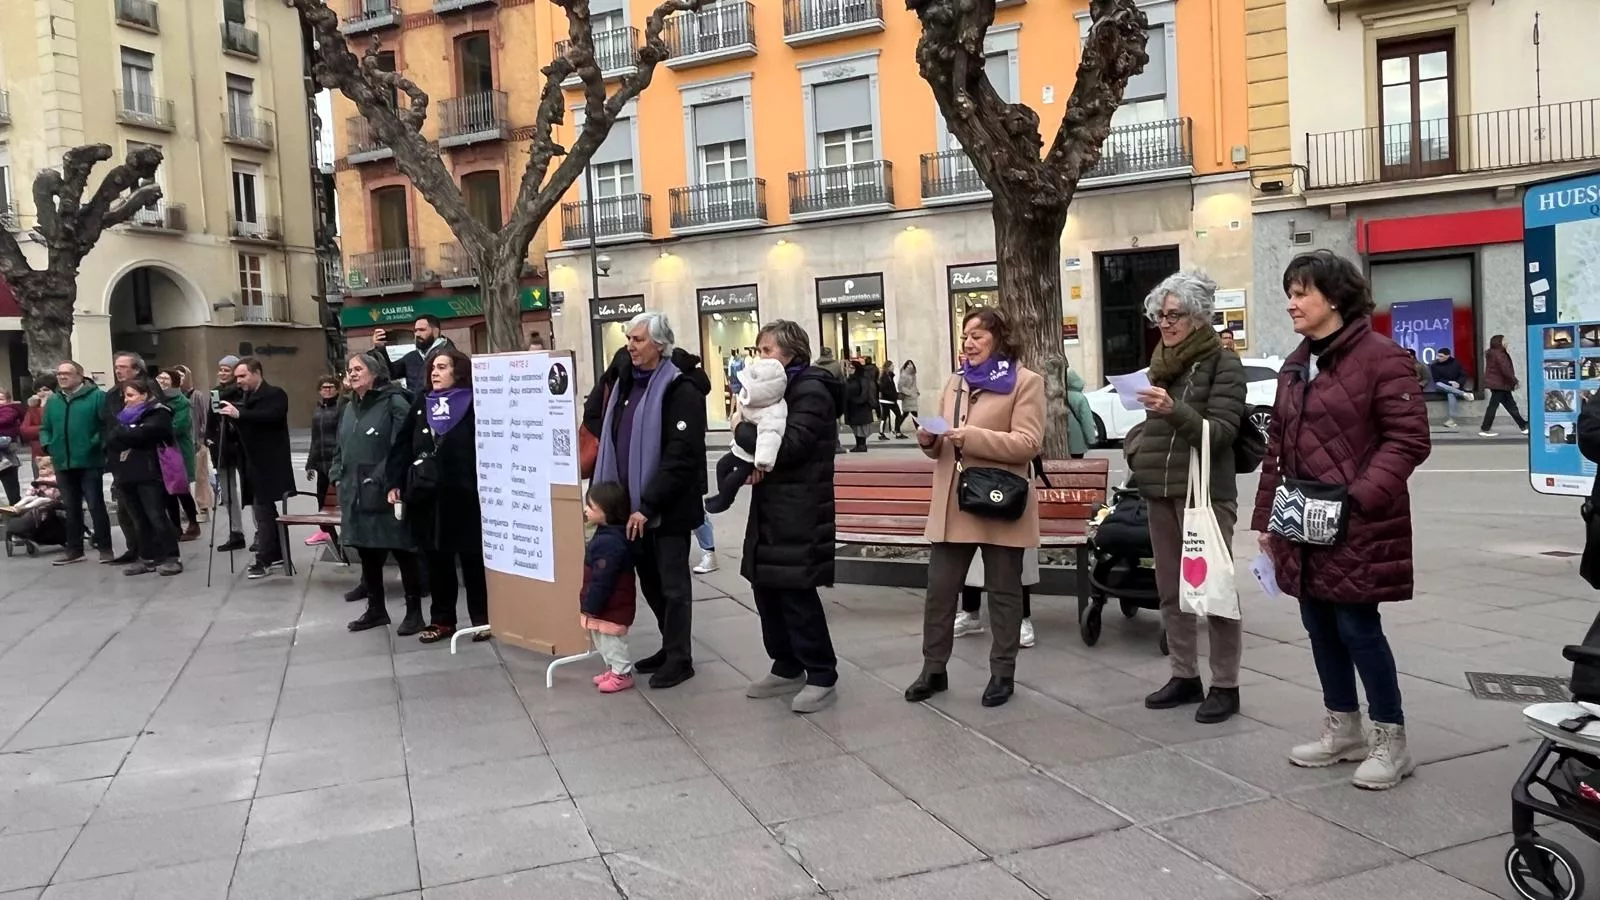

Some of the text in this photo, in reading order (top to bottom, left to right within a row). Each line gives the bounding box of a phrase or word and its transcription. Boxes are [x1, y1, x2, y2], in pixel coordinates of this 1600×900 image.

[1538, 185, 1600, 211] HUES
[1131, 236, 1139, 247] 2
[952, 272, 982, 285] Pilar
[701, 293, 757, 307] Pilar Prieto
[381, 305, 414, 315] CAJA RURAL
[618, 303, 644, 315] Prieto
[1395, 318, 1450, 333] ¿HOLA?
